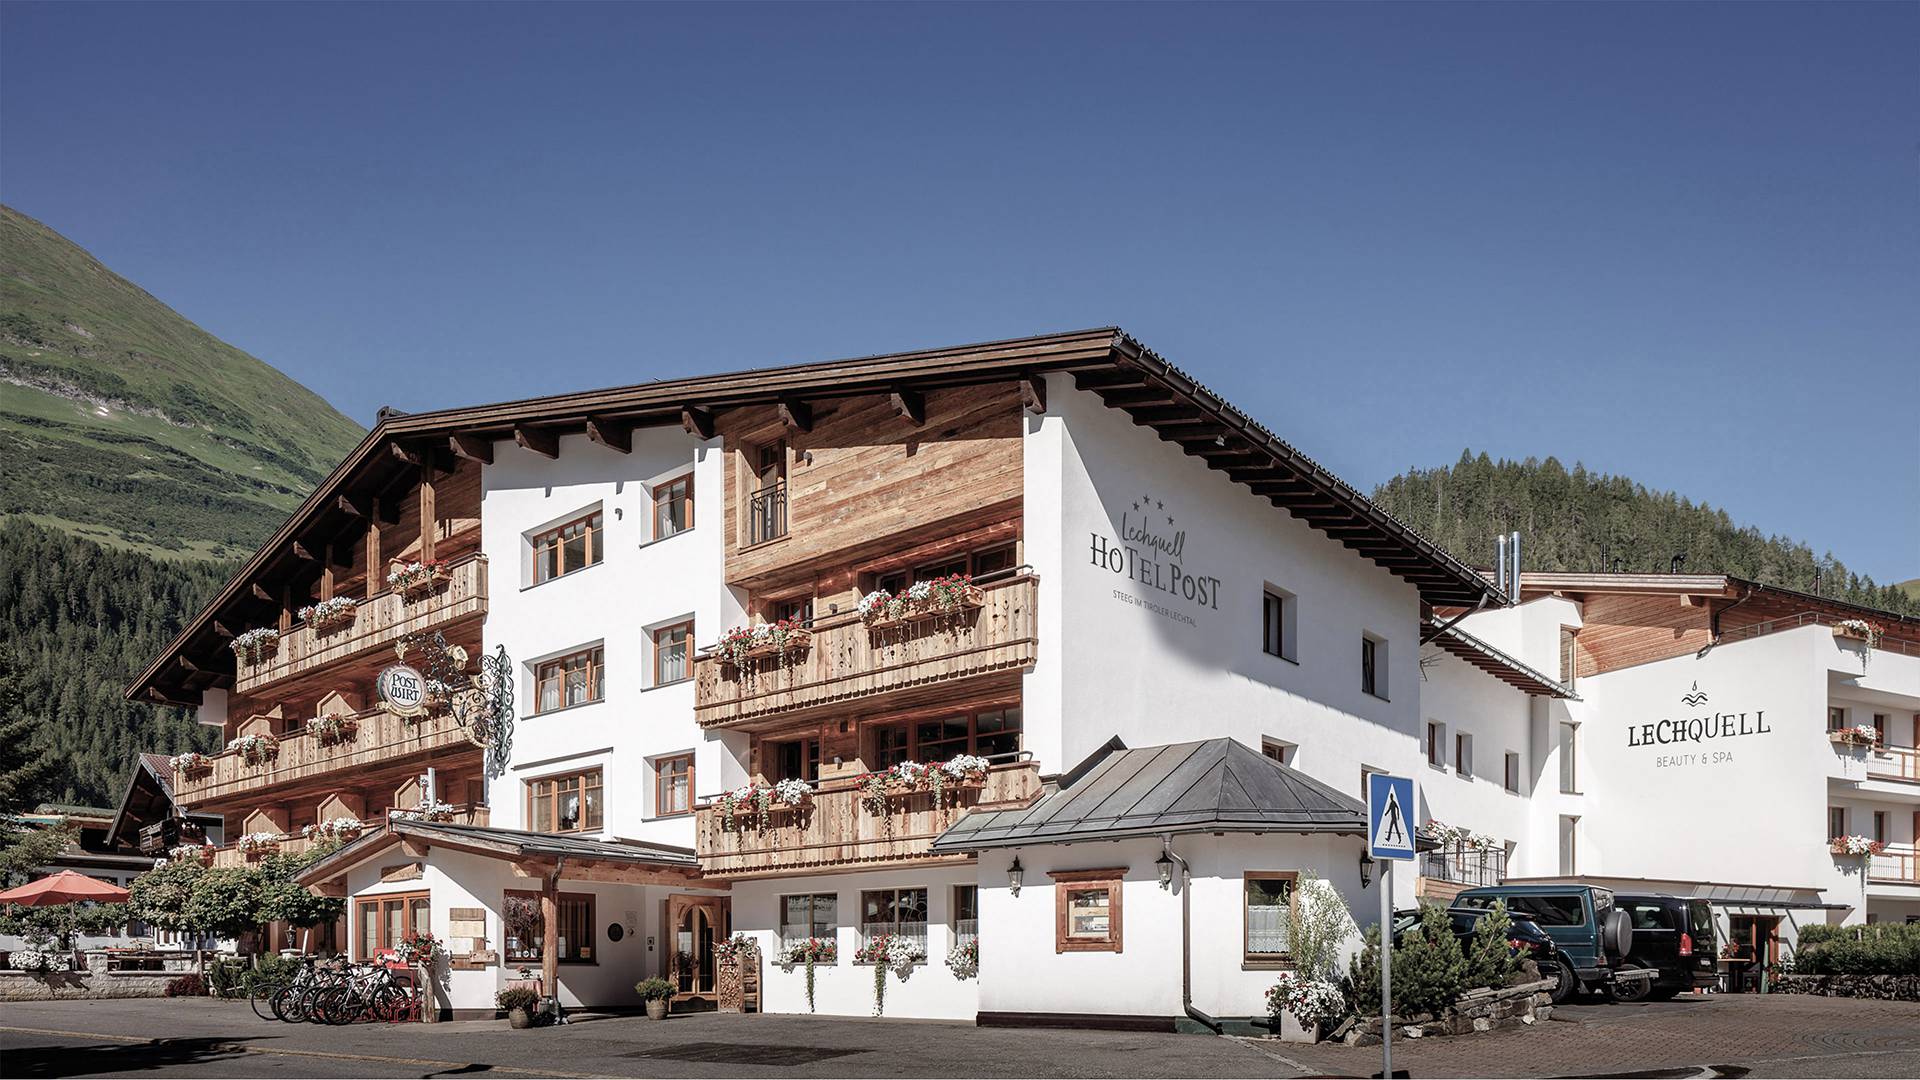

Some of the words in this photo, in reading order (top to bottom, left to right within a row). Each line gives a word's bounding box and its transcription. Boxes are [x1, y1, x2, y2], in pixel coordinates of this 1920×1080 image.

[1122, 511, 1186, 565] Lechquell
[1112, 589, 1133, 604] STEEG
[1134, 597, 1143, 607] IM
[1144, 600, 1169, 618] TIROLER
[1170, 610, 1197, 628] LECHTAL
[390, 686, 419, 701] WIRT
[392, 673, 418, 689] POST
[1627, 710, 1771, 747] LECHQUELL
[1656, 753, 1697, 768] BEAUTY
[1701, 752, 1708, 765] &
[1712, 751, 1734, 764] SPA
